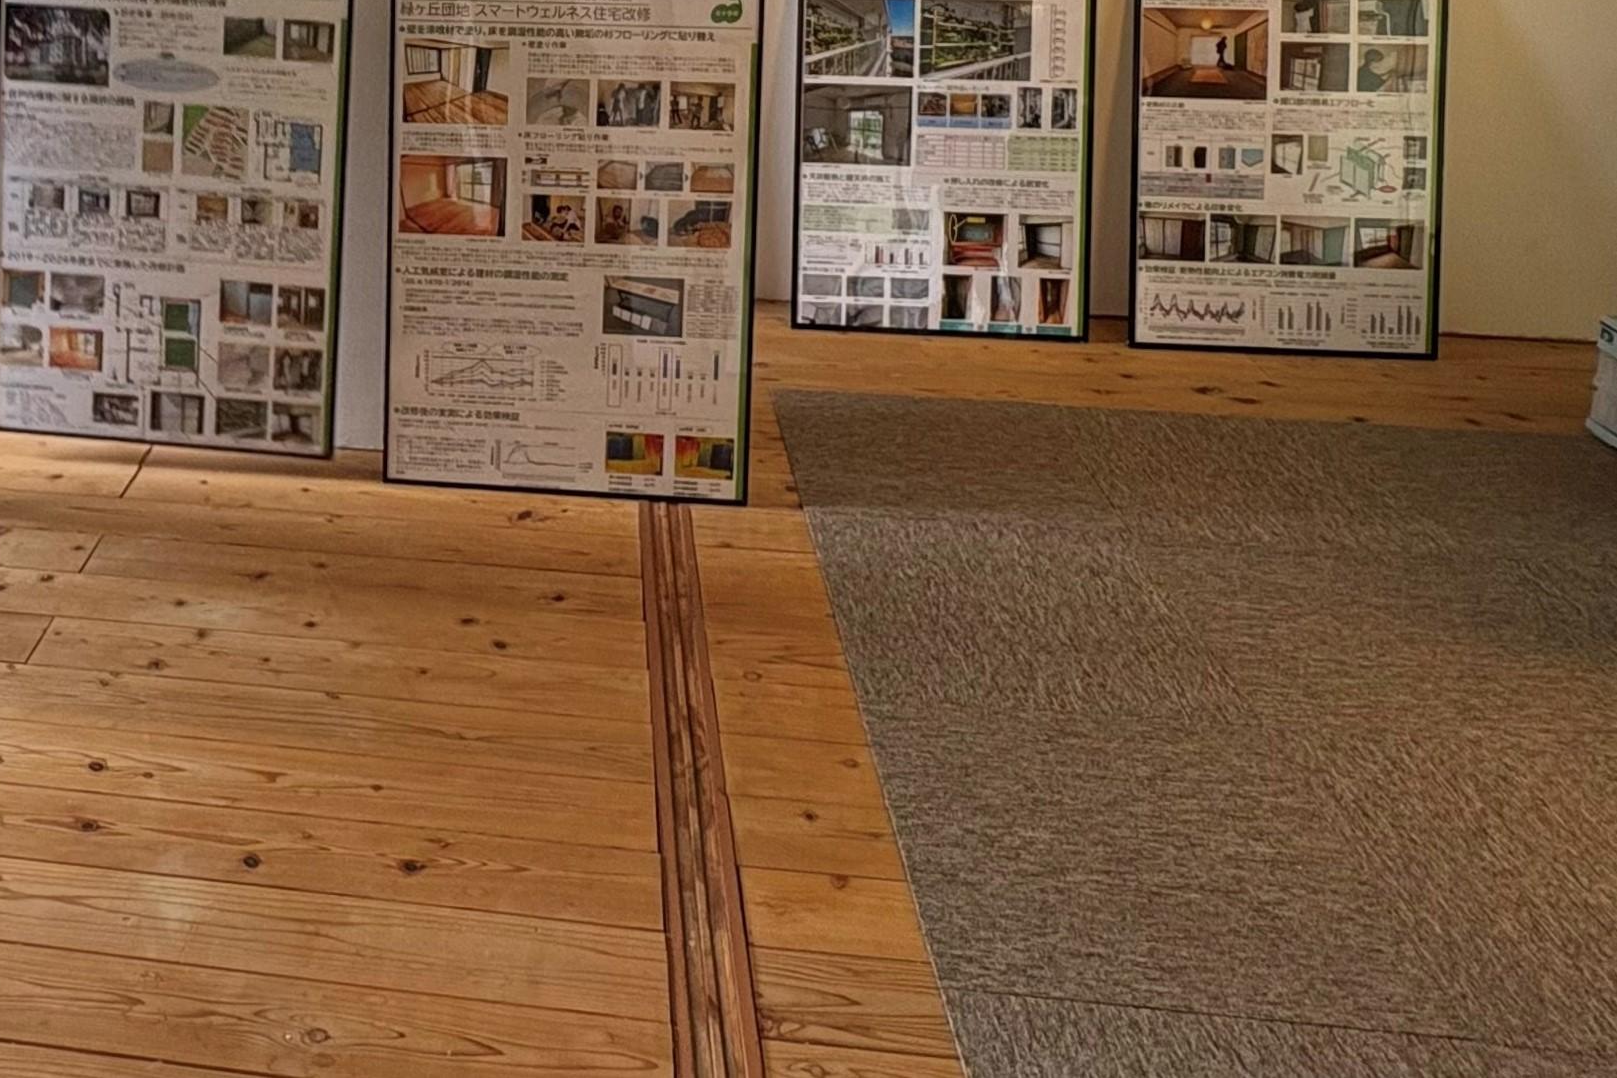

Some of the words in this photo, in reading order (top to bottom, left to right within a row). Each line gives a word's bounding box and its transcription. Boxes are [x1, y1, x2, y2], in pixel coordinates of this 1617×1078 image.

[400, 1, 470, 18] 緑ヶ丘団地
[475, 3, 651, 23] スマートウェルネス住宅改修
